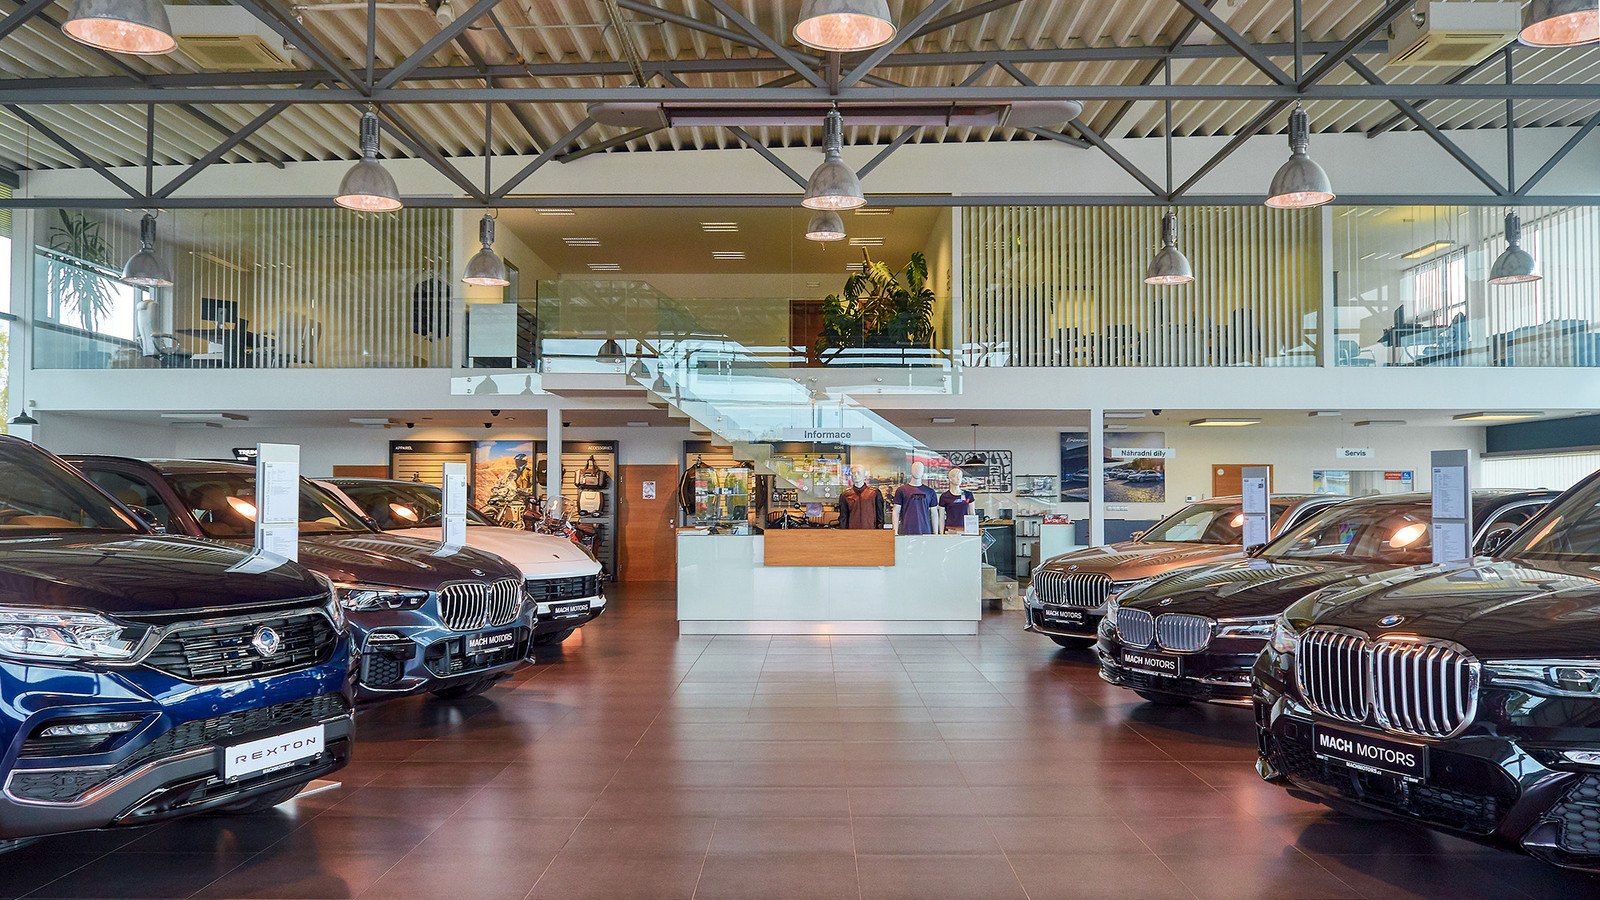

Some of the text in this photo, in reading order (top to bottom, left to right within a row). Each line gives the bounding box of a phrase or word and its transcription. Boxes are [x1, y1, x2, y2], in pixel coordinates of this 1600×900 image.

[804, 430, 852, 439] Informace
[1121, 449, 1167, 458] Náhradní díly
[1344, 449, 1367, 457] Servis
[554, 604, 589, 614] MACH MOTORS
[1045, 609, 1083, 619] MACH MOTORS
[469, 632, 513, 648] MACH MOTORS
[1124, 653, 1176, 670] MACH MOTORS
[235, 737, 316, 765] REXTON
[1320, 733, 1416, 767] MACH MOTORS
